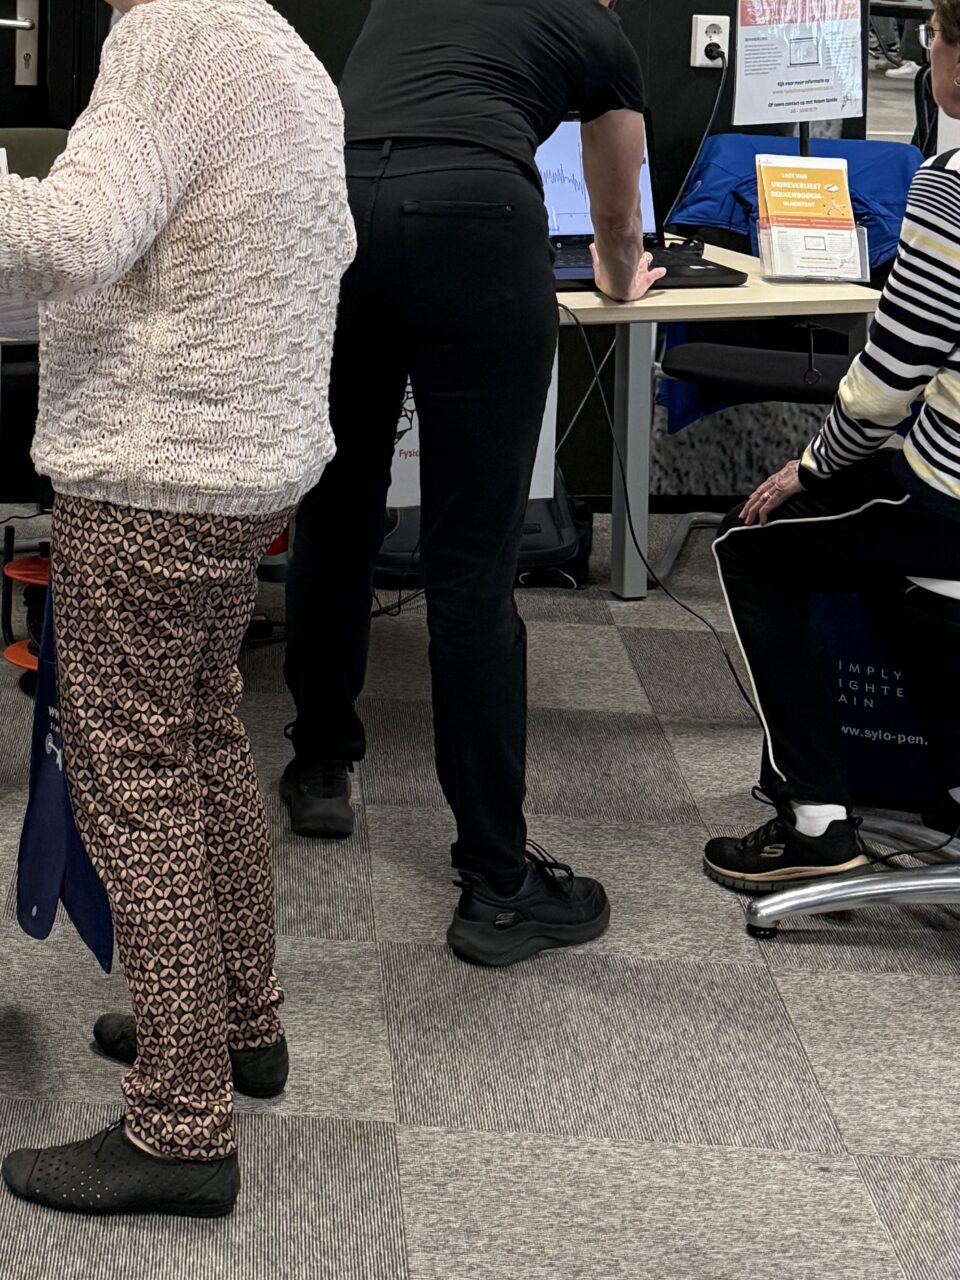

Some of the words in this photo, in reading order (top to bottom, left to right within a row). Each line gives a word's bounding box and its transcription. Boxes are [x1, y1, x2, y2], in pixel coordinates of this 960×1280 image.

[838, 660, 903, 681] IMPLY
[838, 678, 904, 698] IGHTE
[838, 694, 874, 709] AIN
